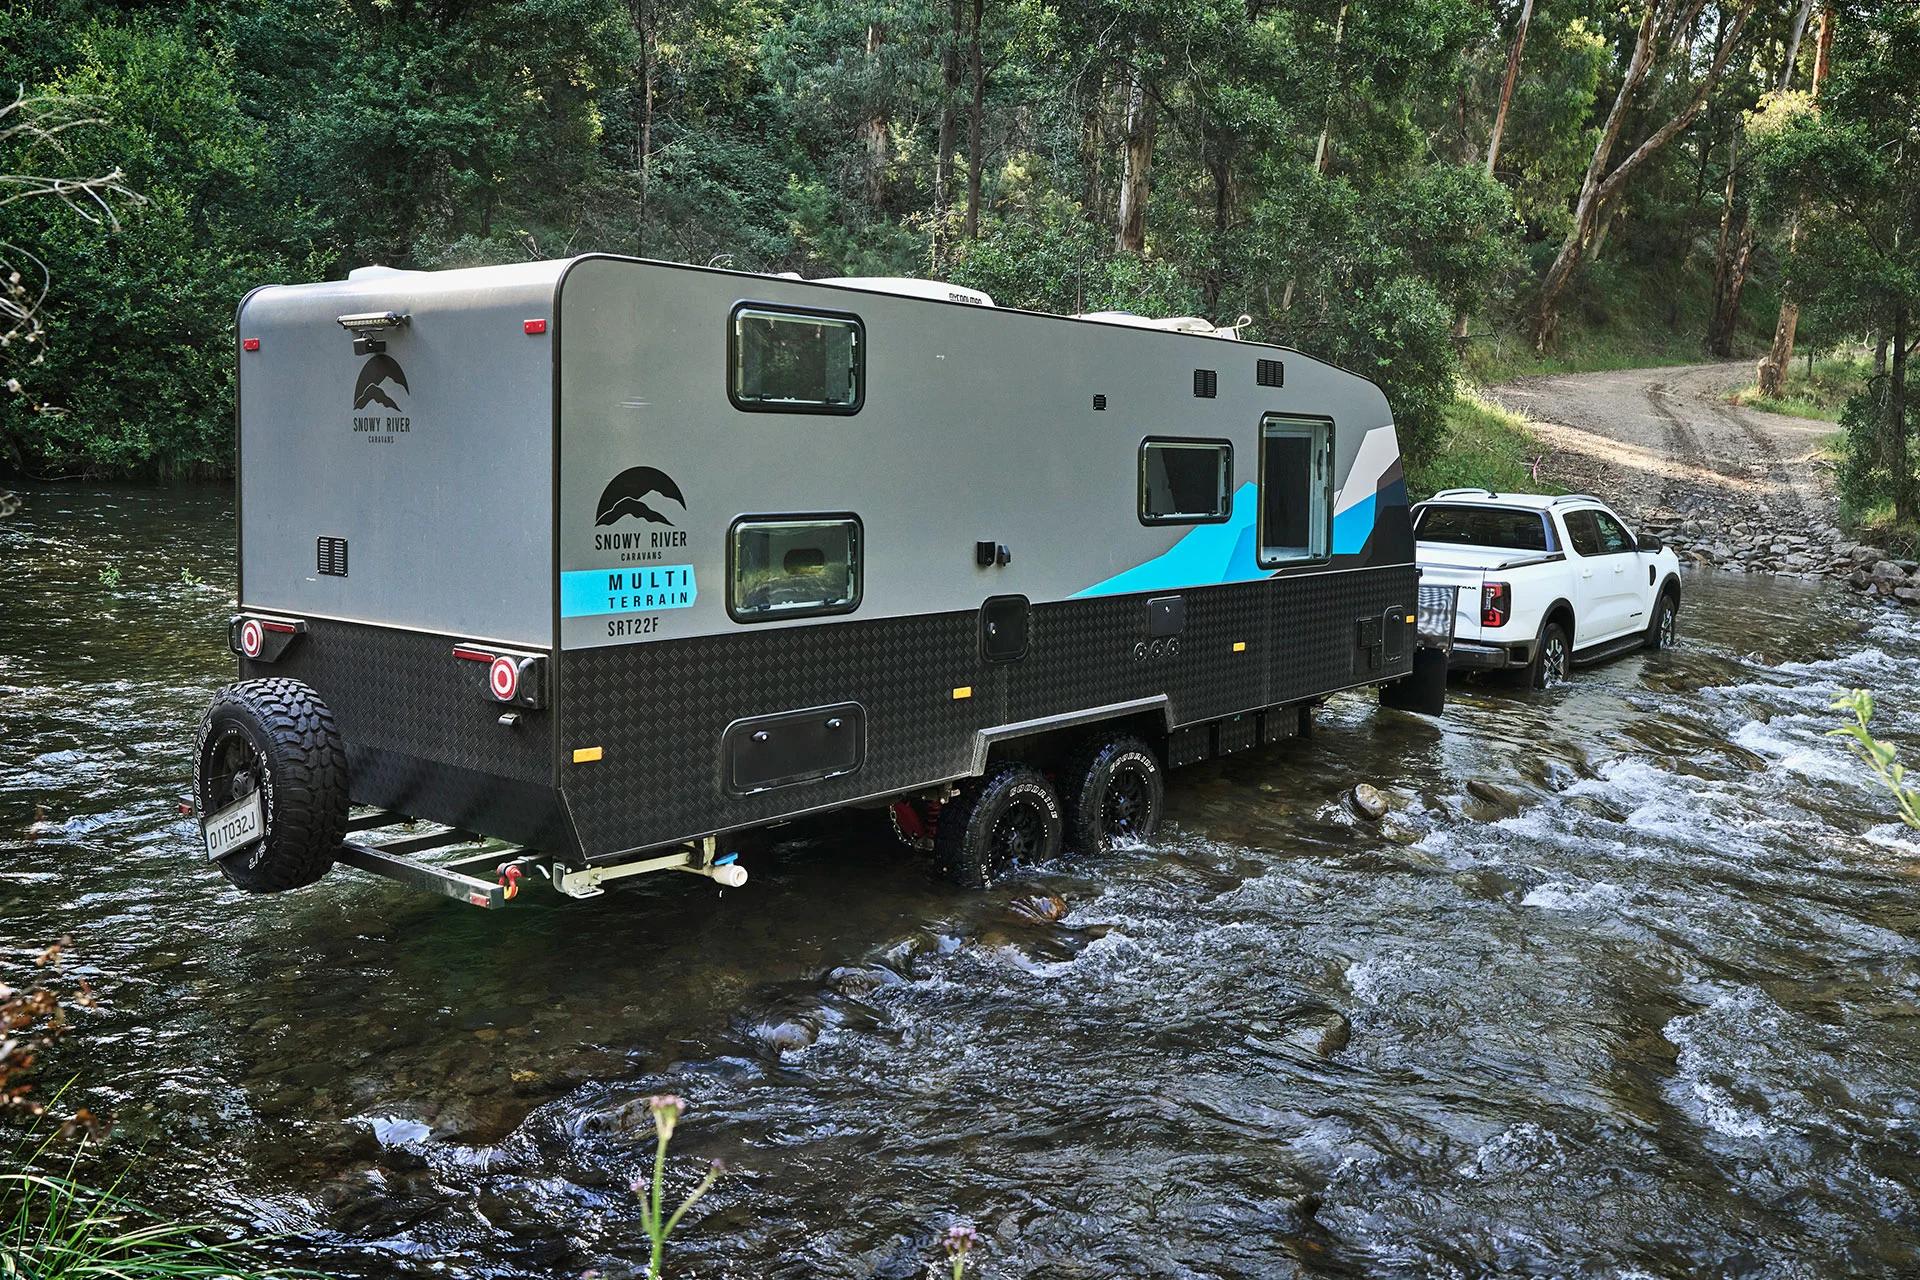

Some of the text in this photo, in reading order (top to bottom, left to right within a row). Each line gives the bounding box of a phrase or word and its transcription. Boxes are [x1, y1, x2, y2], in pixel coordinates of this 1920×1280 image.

[353, 417, 410, 432] SNOWY RIVER
[368, 435, 394, 443] CARAVANS
[595, 531, 687, 550] SNOWY RIVER
[621, 551, 662, 561] CARAVANS
[609, 570, 687, 591] MULTI
[608, 592, 687, 609] TERRAIN
[608, 617, 659, 637] SRT22F
[1109, 752, 1156, 773] GOODRIDE
[1009, 783, 1058, 819] GOODRIDE
